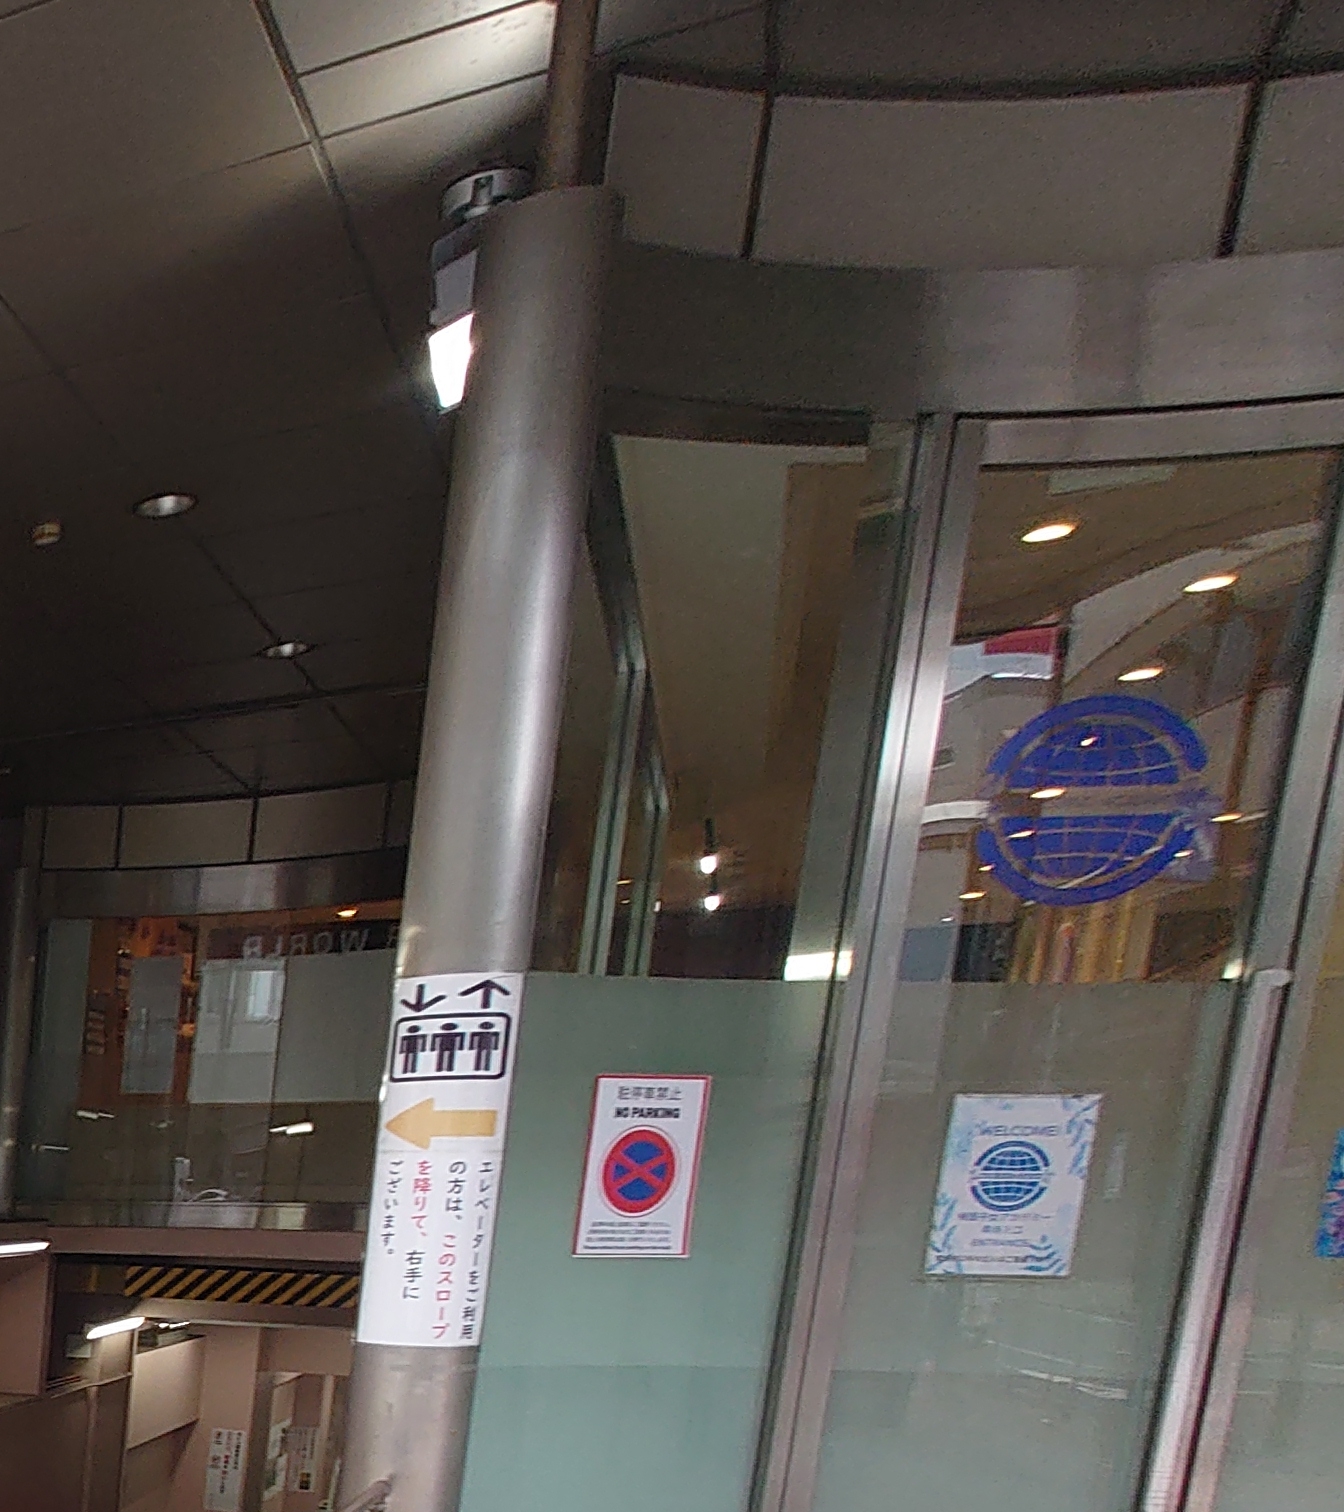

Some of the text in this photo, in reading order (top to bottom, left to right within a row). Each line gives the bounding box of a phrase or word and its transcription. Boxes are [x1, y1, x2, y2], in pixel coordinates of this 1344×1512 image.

[614, 1107, 680, 1119] NO PARKING
[380, 1160, 404, 1255] ございます。
